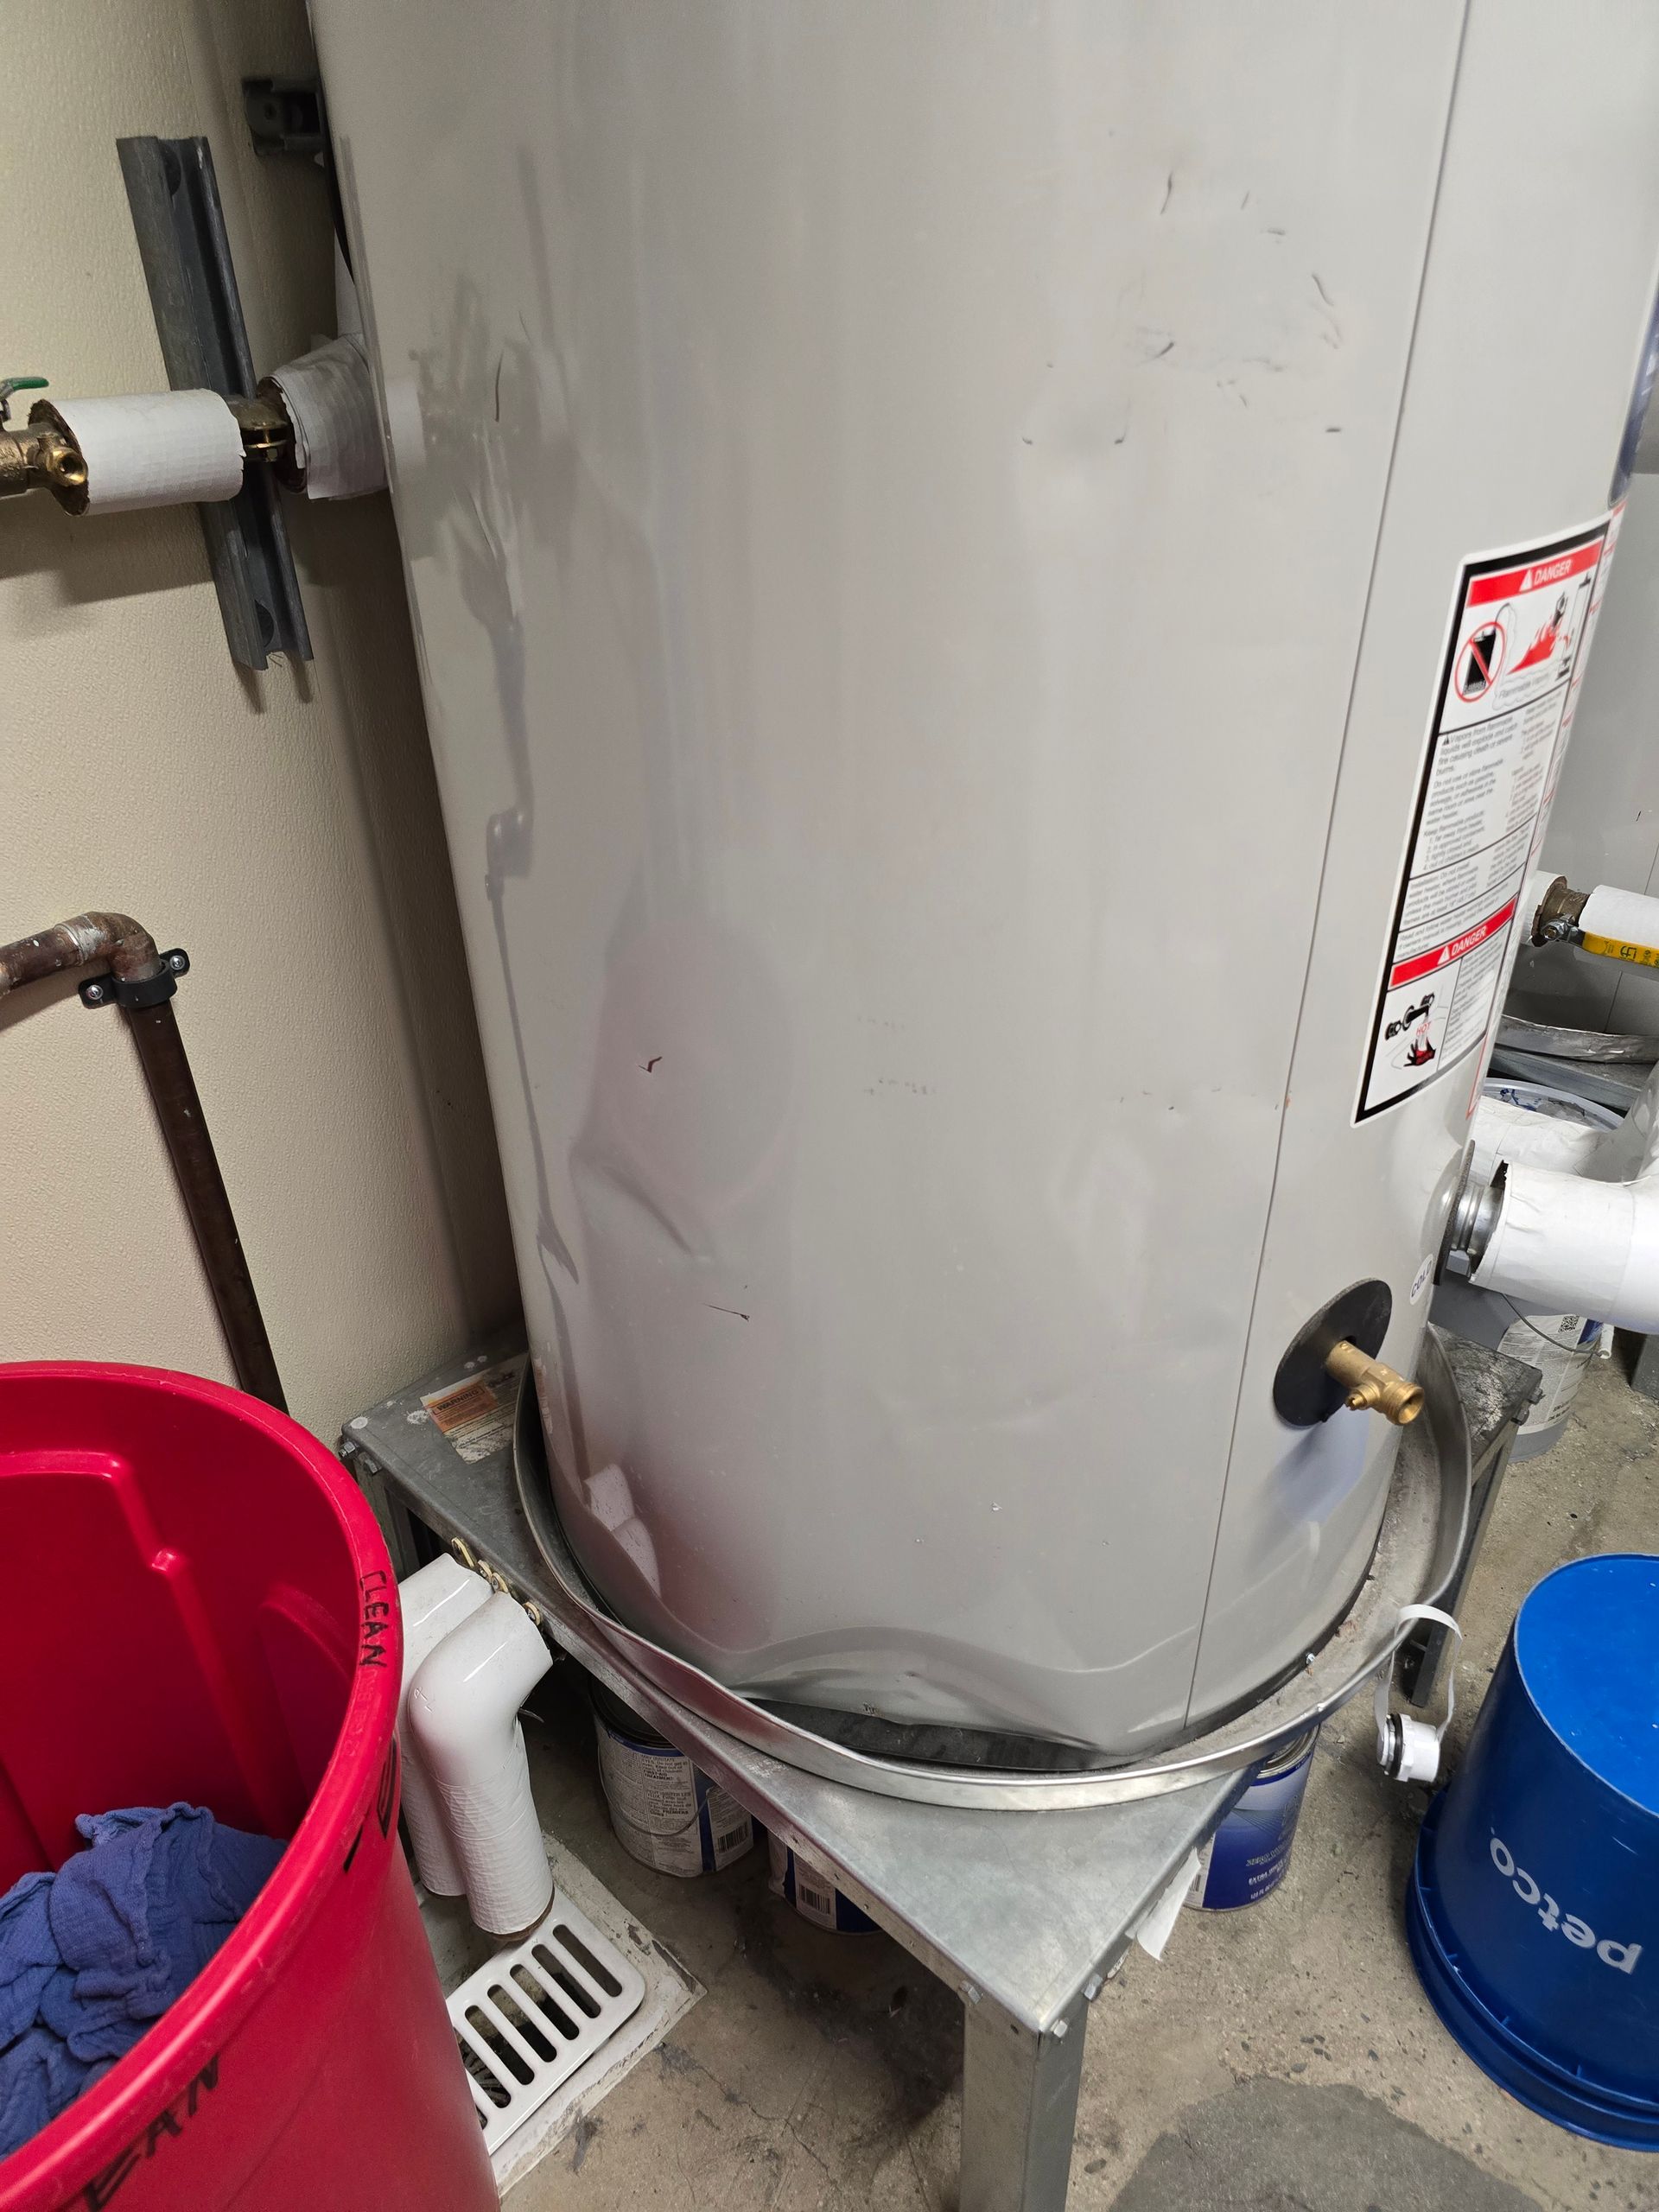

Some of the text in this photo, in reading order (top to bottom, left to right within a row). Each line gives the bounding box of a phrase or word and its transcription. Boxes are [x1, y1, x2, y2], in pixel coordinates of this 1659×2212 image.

[1534, 559, 1572, 585] DANGER
[1452, 925, 1488, 956] DANGER
[1415, 1021, 1431, 1036] HOT
[1411, 1261, 1432, 1298] COLD
[436, 1389, 479, 1411] WARNING
[359, 1570, 389, 1669] CLEAN
[1491, 1838, 1643, 1974] petco
